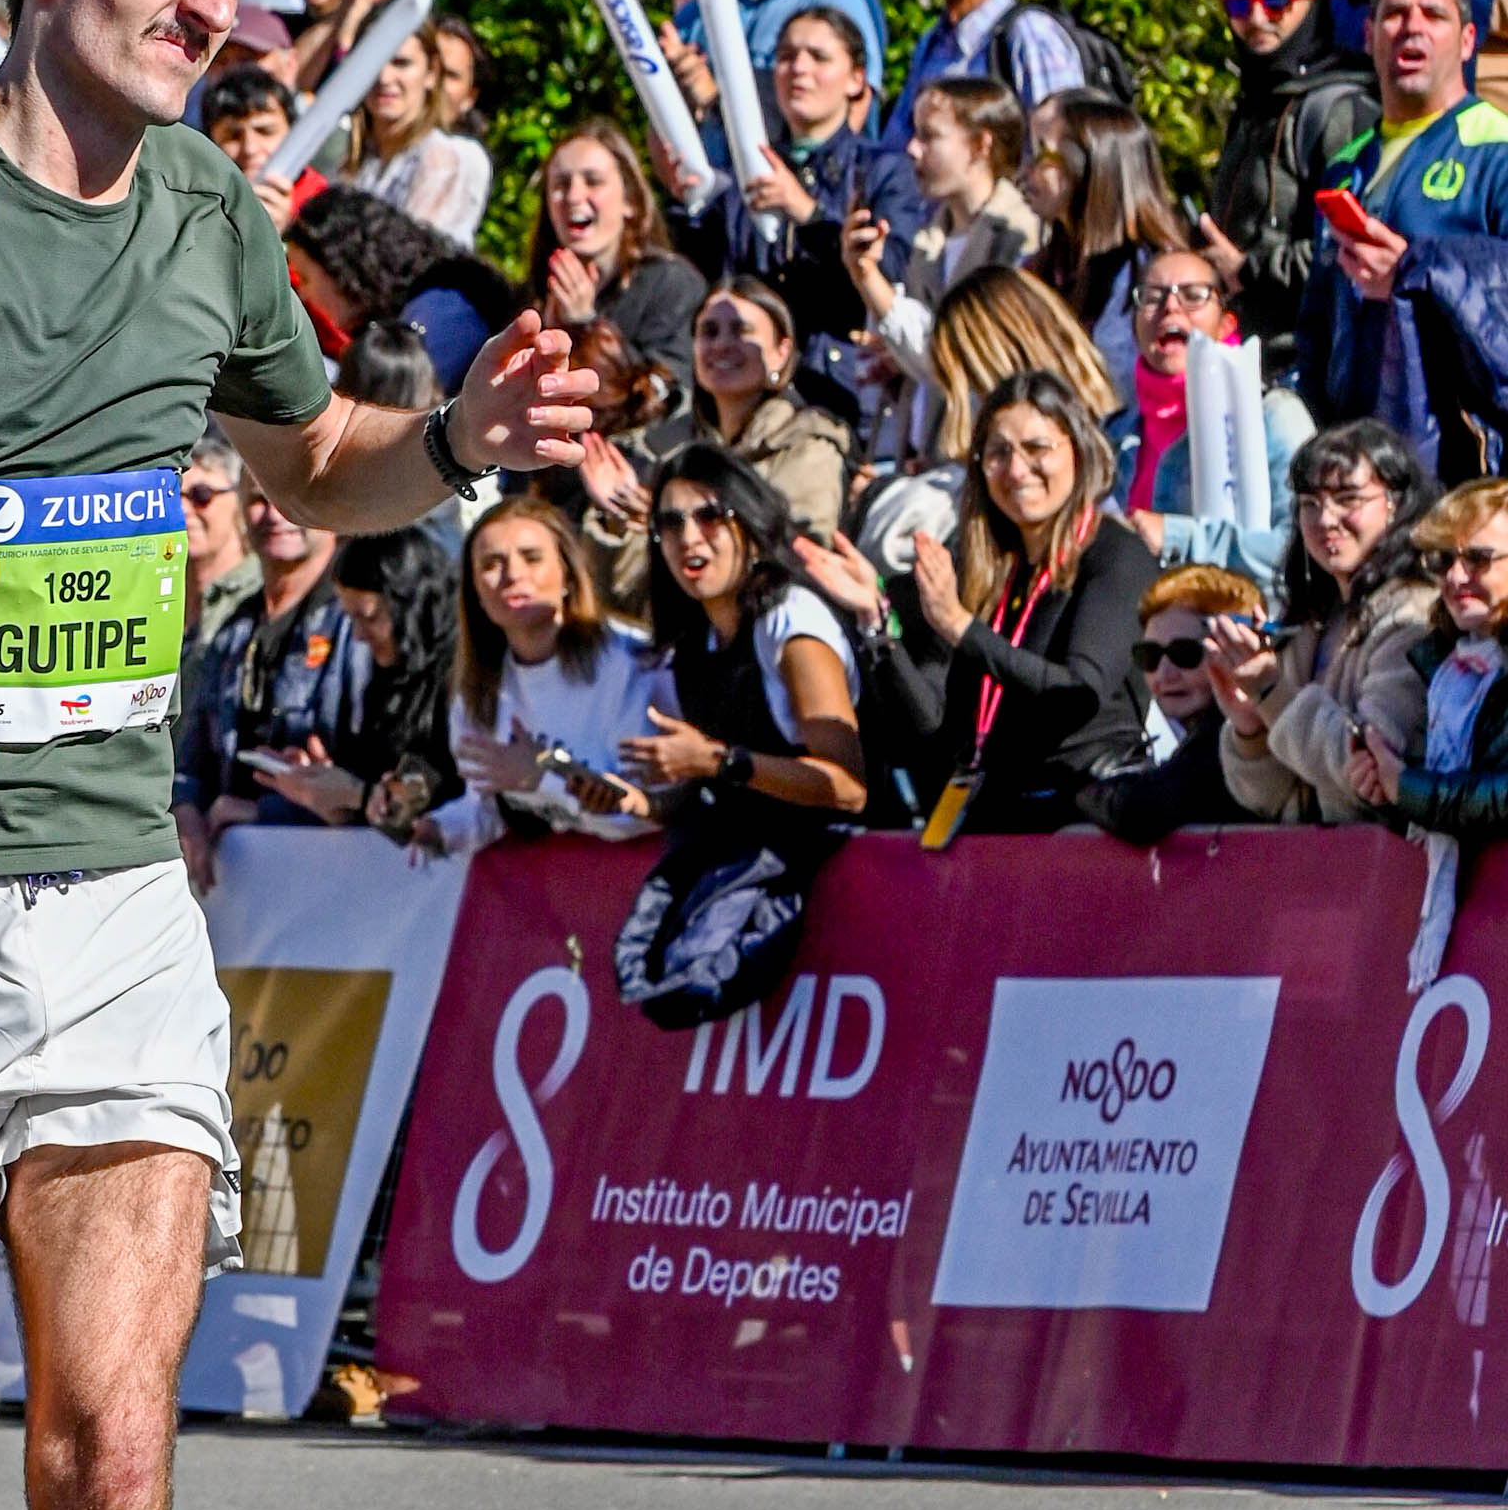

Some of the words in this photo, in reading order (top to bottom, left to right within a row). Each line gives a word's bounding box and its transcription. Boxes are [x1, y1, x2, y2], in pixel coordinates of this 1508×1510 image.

[41, 488, 166, 528] ZURICH
[82, 545, 109, 554] SEVILLA
[44, 570, 112, 604] 1892
[683, 974, 886, 1099] IMD
[592, 1175, 732, 1229] Instituto
[739, 1181, 913, 1246] Municipal
[627, 1244, 674, 1292] de
[680, 1246, 841, 1308] Deportes
